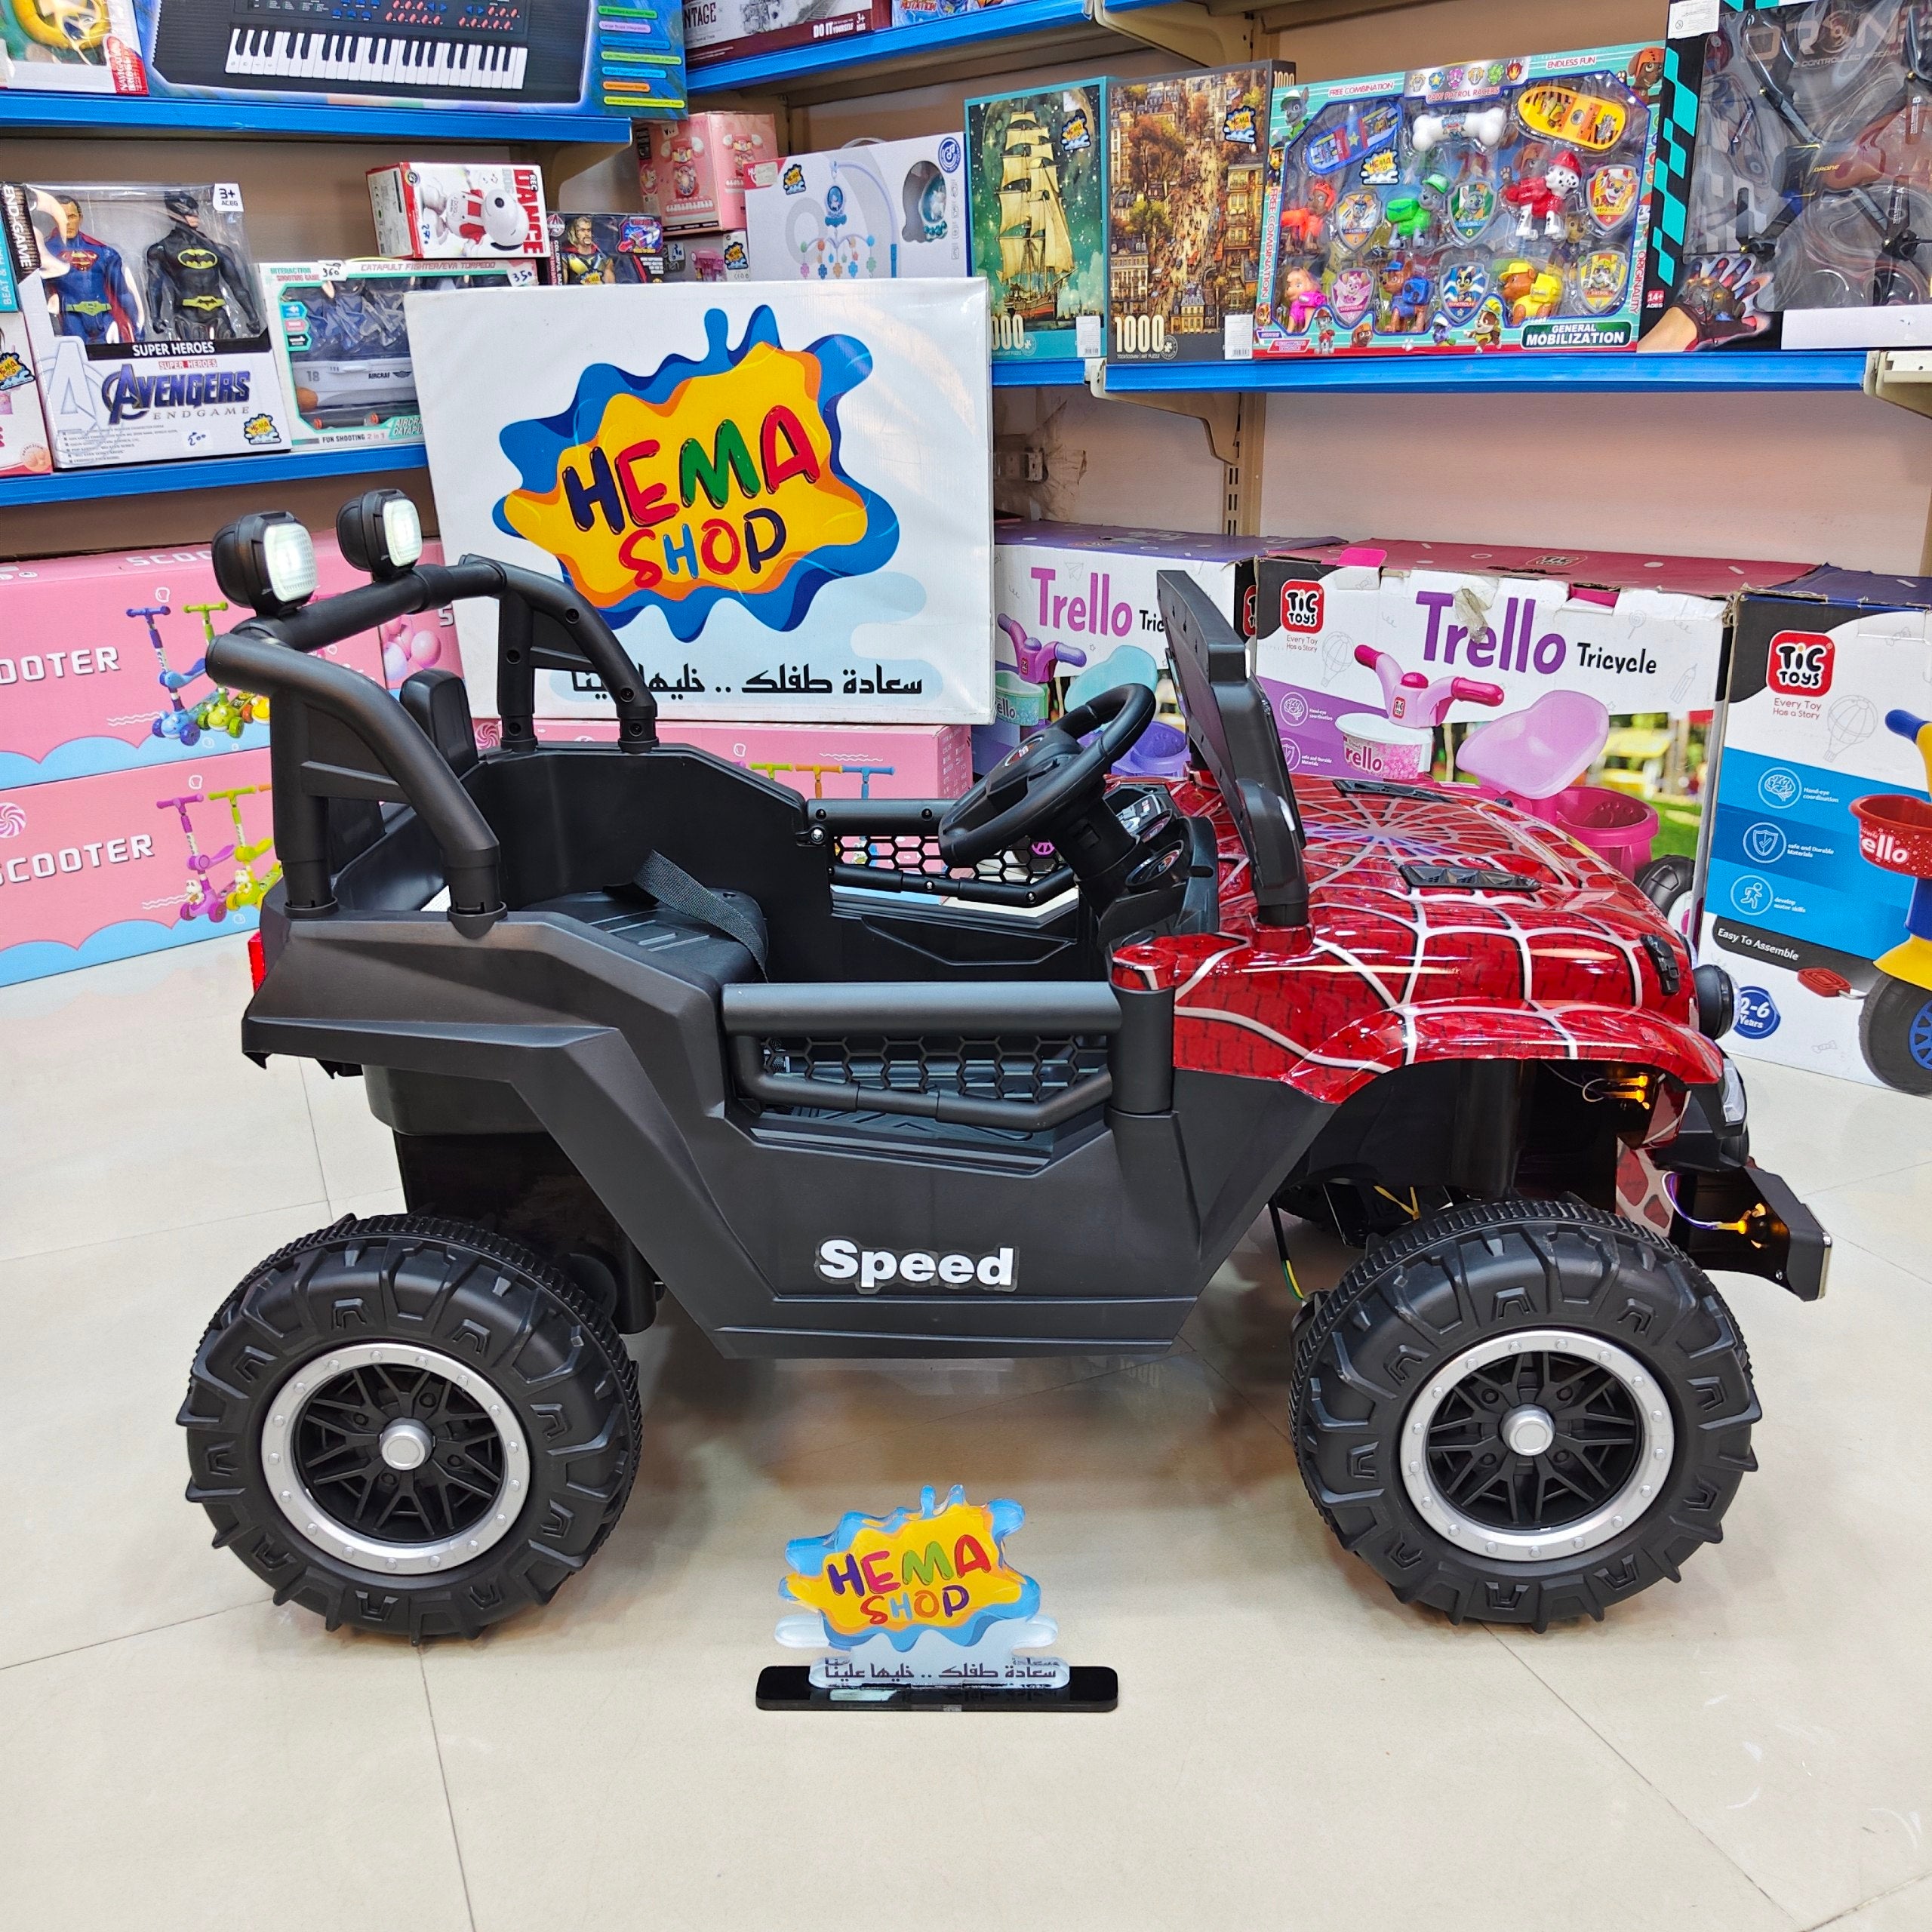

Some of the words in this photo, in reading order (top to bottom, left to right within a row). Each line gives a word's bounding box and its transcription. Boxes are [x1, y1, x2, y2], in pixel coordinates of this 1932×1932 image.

[685, 2, 716, 28] NTAGE
[1547, 59, 1579, 69] ENDLESS
[1580, 57, 1596, 66] FUN
[1328, 88, 1344, 97] FREE
[1344, 82, 1394, 95] COMBINATION
[1445, 89, 1471, 100] PATROL
[219, 188, 235, 199] 3+
[1268, 188, 1279, 213] FREE
[514, 170, 543, 254] DANCE
[4, 184, 32, 268] END-GAME
[1261, 214, 1276, 299] COMBINATION
[361, 263, 403, 272] CATAPULT
[1629, 251, 1647, 314] ORIGINALITY
[1648, 291, 1664, 302] 14+
[992, 314, 1024, 350] 000
[1114, 314, 1164, 353] 1000
[1552, 324, 1596, 334] GENERAL
[1526, 332, 1624, 346] MOBILIZATION
[132, 343, 170, 357] SUPER
[172, 341, 215, 355] HEROES
[158, 361, 184, 370] SUPER
[188, 359, 217, 369] HEROES
[101, 364, 251, 425] AVENGERS
[153, 406, 250, 420] ENDGAME
[396, 417, 423, 427] AIRCRA
[336, 434, 365, 442] SHOOTING
[561, 404, 820, 535] HEMA
[618, 507, 786, 588] SHOP
[1031, 567, 1133, 637] Trello
[1139, 609, 1166, 632] Tric
[1286, 635, 1305, 645] Every
[1306, 636, 1318, 645] Toy
[1416, 591, 1566, 674] Trello
[1577, 642, 1657, 674] Tricycle
[1286, 642, 1297, 651] Has
[1303, 645, 1318, 653] Story
[0, 646, 121, 685] OOTER
[741, 663, 833, 694] طفلك
[842, 663, 923, 694] سعادة
[995, 698, 1016, 718] ello
[1773, 708, 1789, 716] Has
[1798, 710, 1820, 720] Story
[1774, 698, 1801, 709] Every
[1804, 700, 1822, 712] Toy
[1343, 737, 1382, 771] rello
[1802, 794, 1839, 803] coordination
[1803, 787, 1830, 796] Hand-eye
[1787, 849, 1813, 857] Materials
[1861, 834, 1908, 863] ello
[0, 834, 155, 886] COOTER
[1774, 897, 1796, 906] develop
[1718, 928, 1740, 943] Easy
[1741, 935, 1752, 946] To
[1753, 940, 1799, 960] Assemble
[1740, 997, 1770, 1018] 2-6
[1740, 1014, 1764, 1028] Years
[819, 1239, 1014, 1287] Speed
[826, 1534, 992, 1598] HEMA
[860, 1584, 970, 1625] SHOP
[825, 1663, 866, 1681] علينا
[870, 1663, 915, 1681] خليها
[937, 1663, 998, 1678] طفلك
[1004, 1663, 1056, 1678] سعادة
